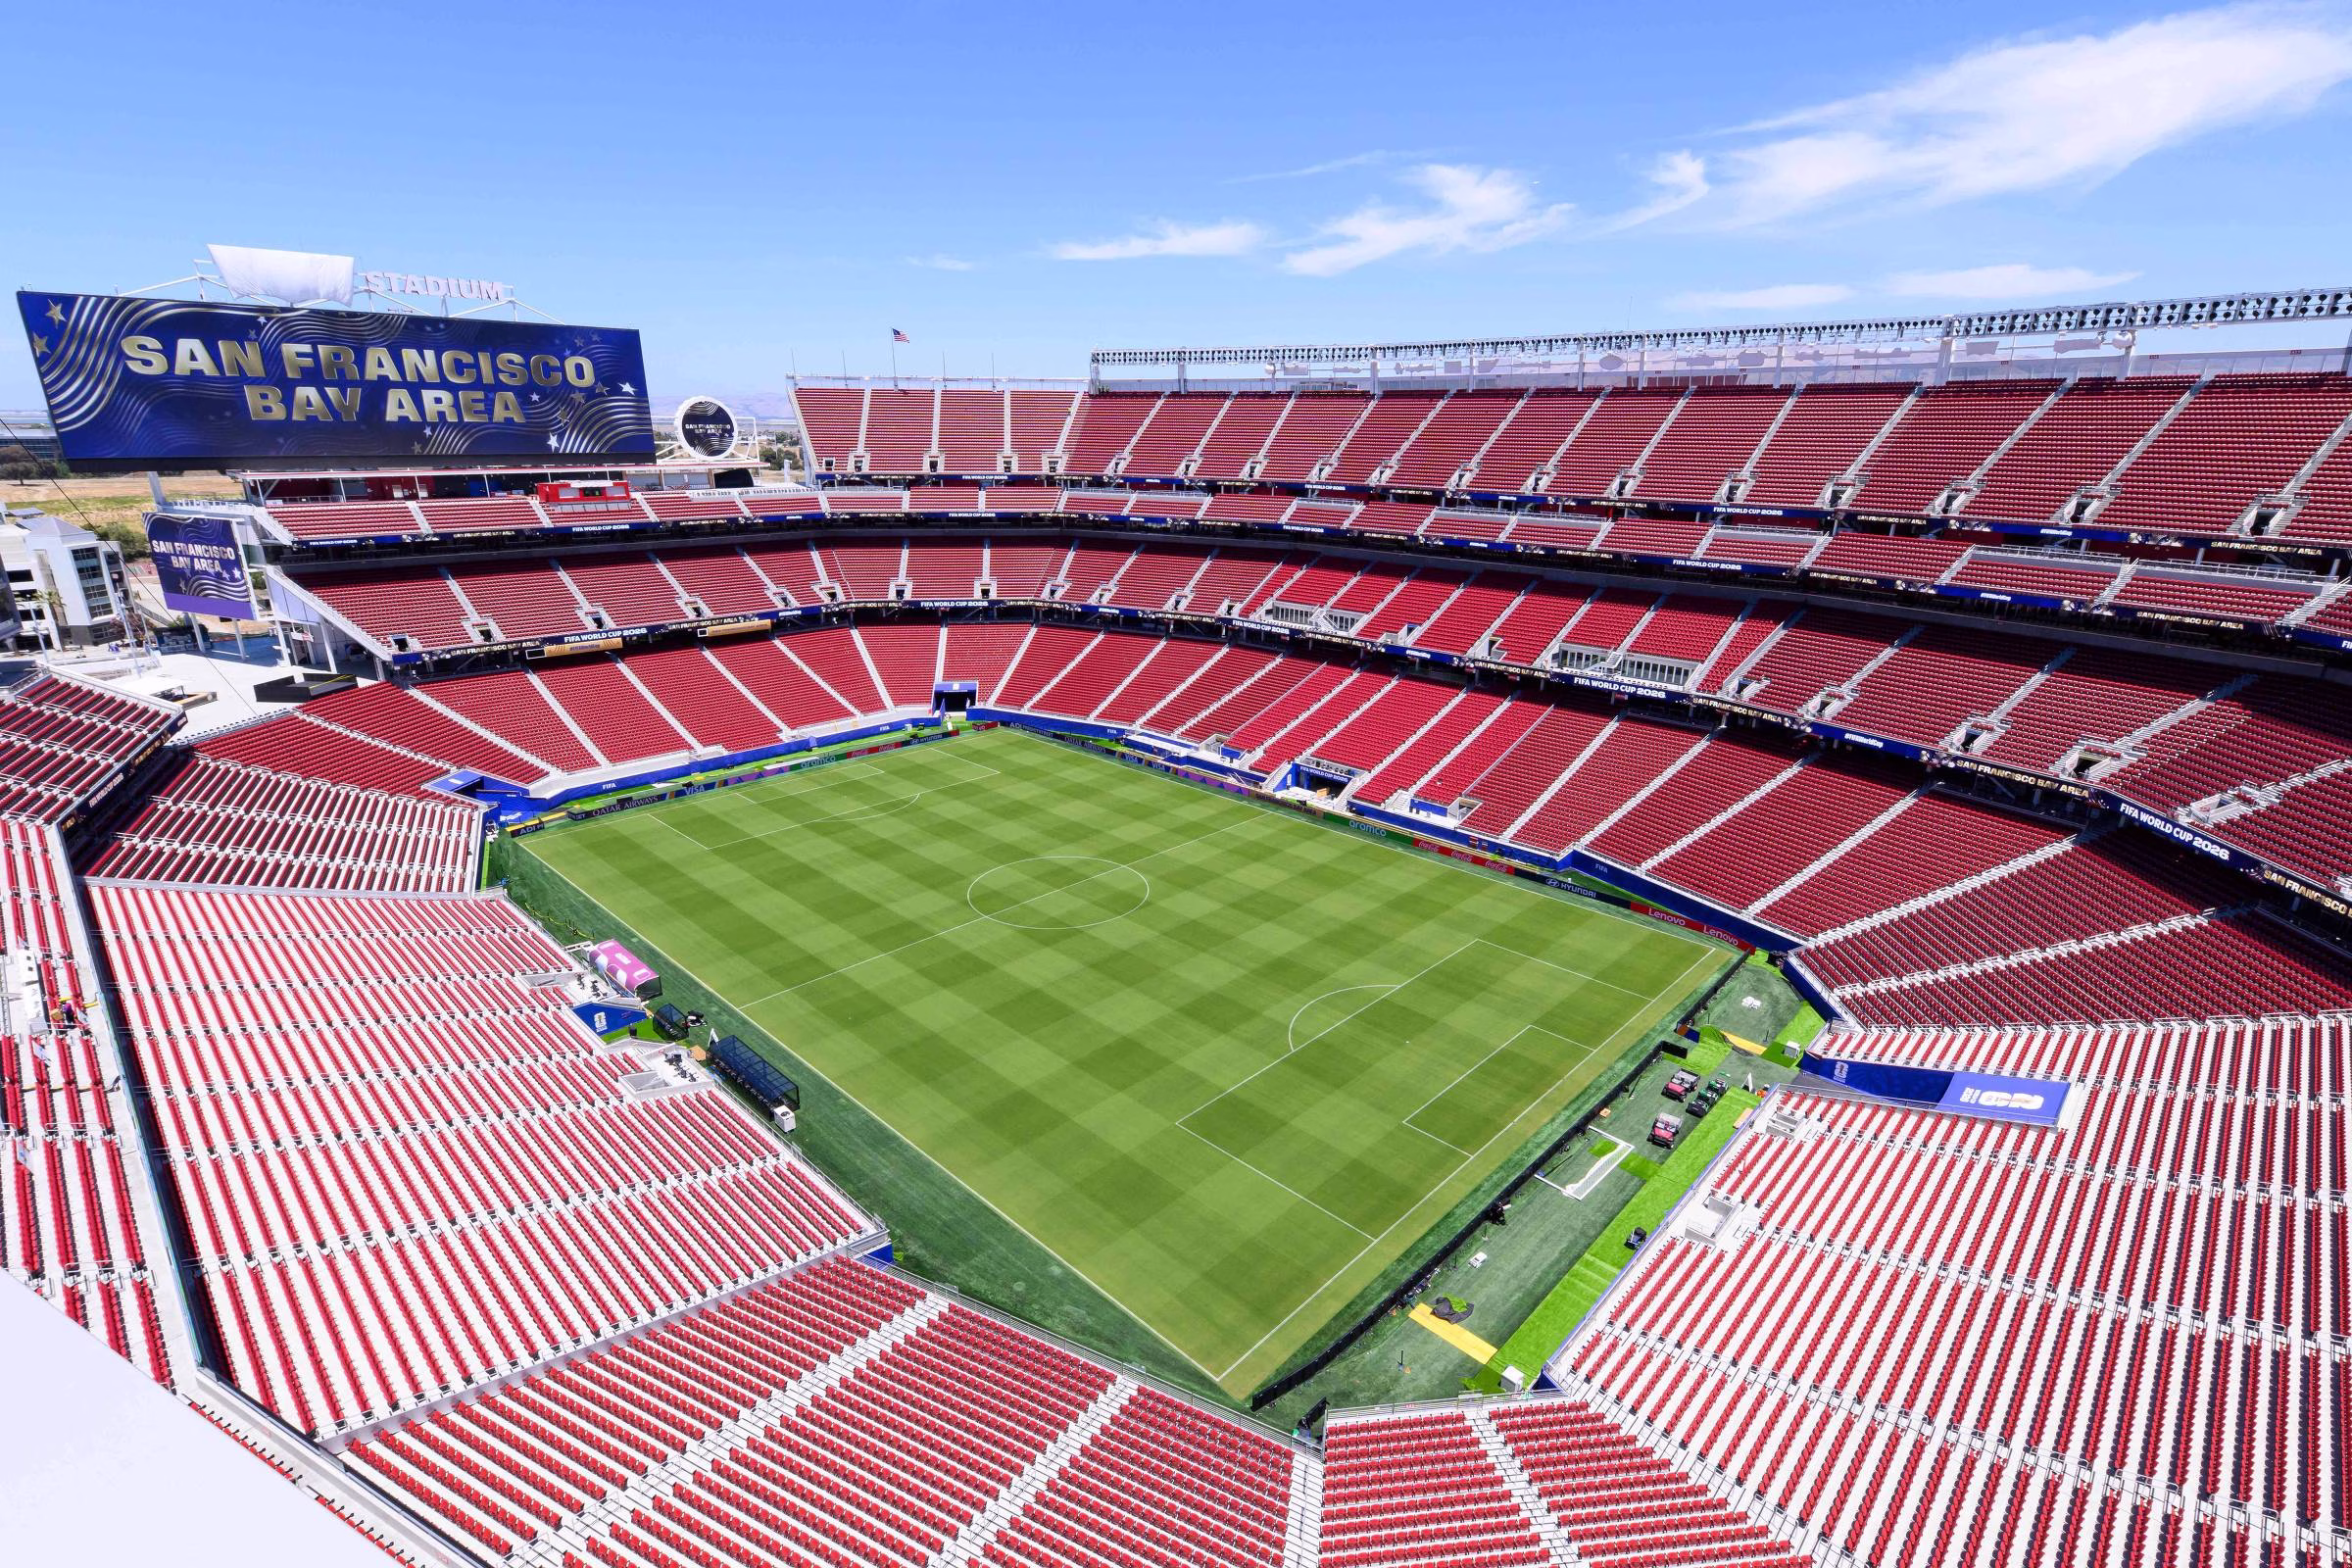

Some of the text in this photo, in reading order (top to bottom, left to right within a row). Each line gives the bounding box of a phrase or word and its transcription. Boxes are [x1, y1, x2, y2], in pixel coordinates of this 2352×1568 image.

[366, 272, 504, 300] STADIUM
[122, 335, 596, 388] SAN FRANCISCO
[244, 385, 526, 423] BAY AREA
[151, 539, 236, 561] SAN FRANCISCO
[2297, 547, 2322, 556] AREA
[171, 555, 223, 573] BAY AREA
[2137, 611, 2154, 619] SAN
[2220, 620, 2244, 630] AREA
[579, 632, 605, 641] WORLD
[1574, 677, 1666, 699] FIFA WORLD CUP 2026
[800, 756, 835, 767] aramco
[1956, 760, 1977, 772] SAN
[1978, 765, 2036, 785] FRANCISCO
[2060, 783, 2089, 797] AREA
[684, 785, 705, 795] VISA
[592, 796, 658, 816] QATAR AIRWAYS
[1348, 820, 1387, 837] aramco
[2119, 803, 2230, 861] FIFA WORLD CUP 2026
[1595, 863, 1608, 873] FIFA
[1561, 882, 1596, 898] HYUNDAI
[2263, 870, 2346, 914] SAN FRANCISCO
[1648, 907, 1686, 926] Lenovo
[1703, 925, 1739, 946] Lenovo
